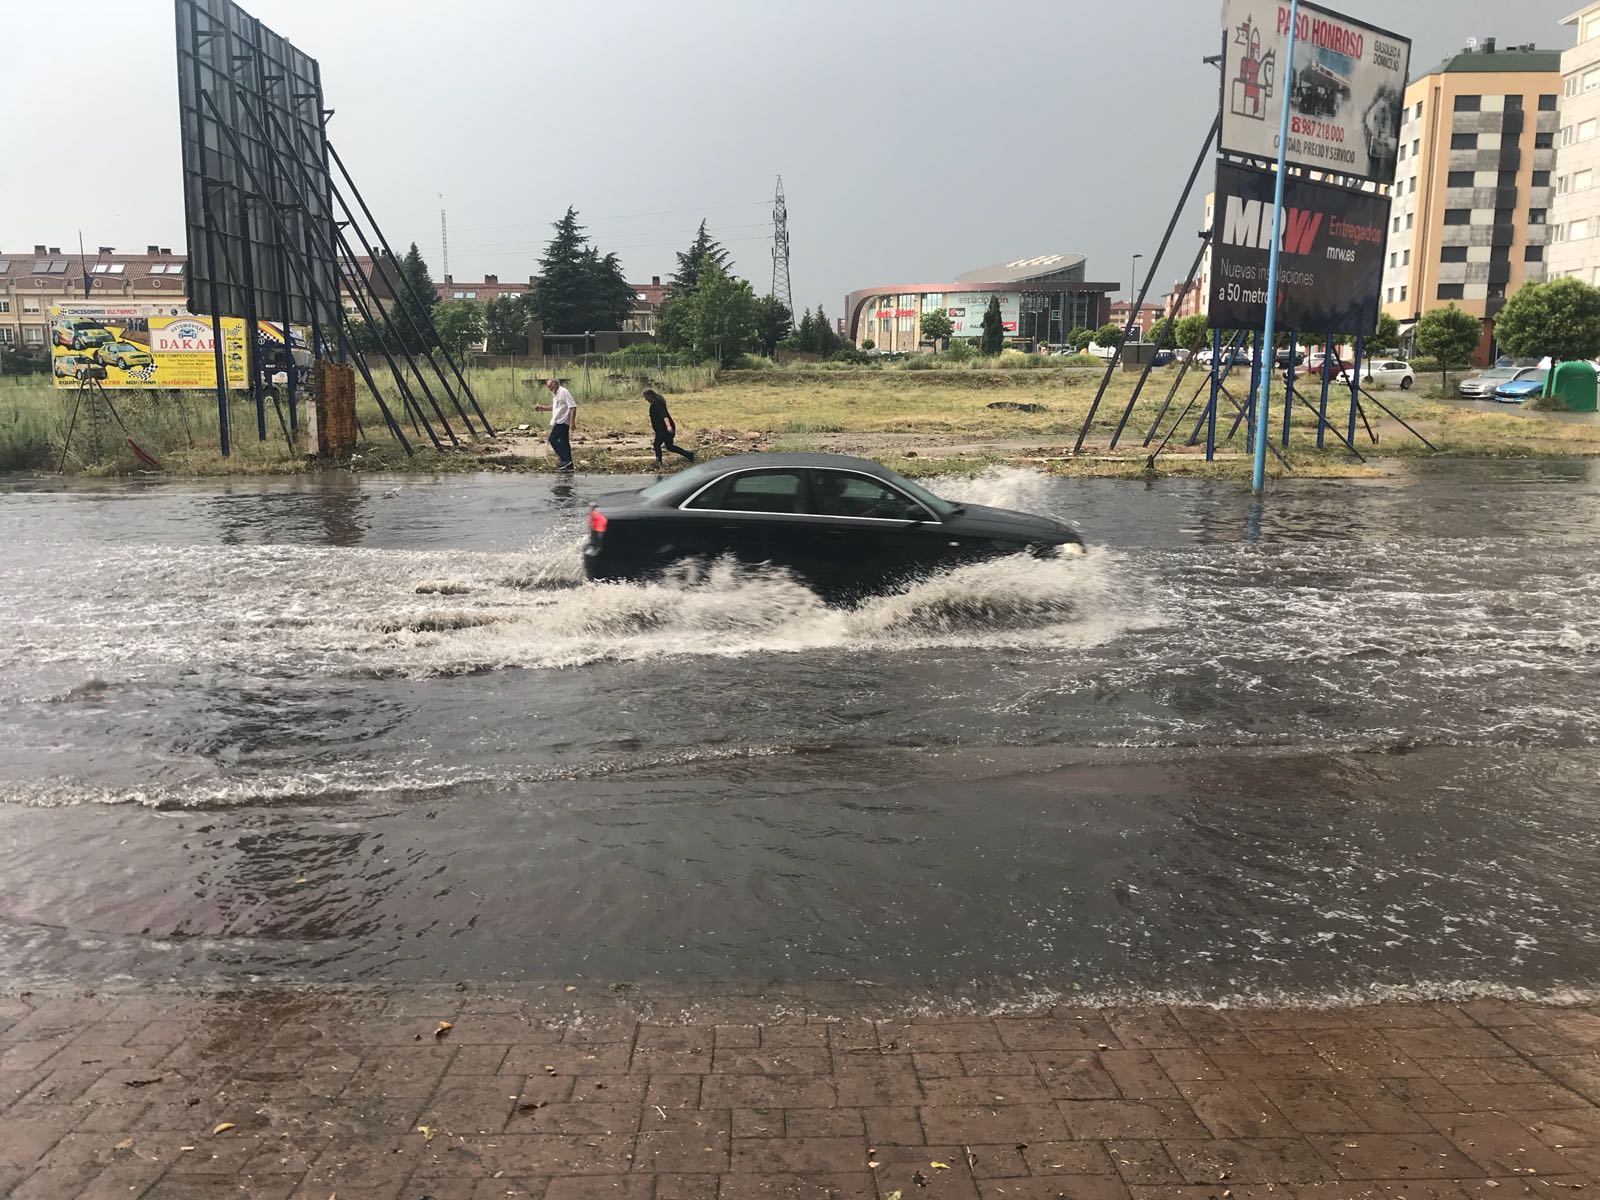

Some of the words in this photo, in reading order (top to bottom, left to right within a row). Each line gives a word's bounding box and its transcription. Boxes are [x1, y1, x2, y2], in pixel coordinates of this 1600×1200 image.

[1311, 18, 1364, 59] HONROSO
[1301, 119, 1316, 136] 987
[1316, 124, 1330, 140] 218
[1331, 127, 1345, 143] 000
[1302, 143, 1324, 159] PRECIO
[1329, 147, 1355, 164] SERVICIO
[1222, 195, 1323, 256] MRW
[1329, 215, 1382, 245] Entregados
[1326, 245, 1356, 262] mrw.es
[1220, 257, 1256, 280] Nuevas
[1218, 288, 1225, 301] a
[1227, 283, 1240, 302] 50
